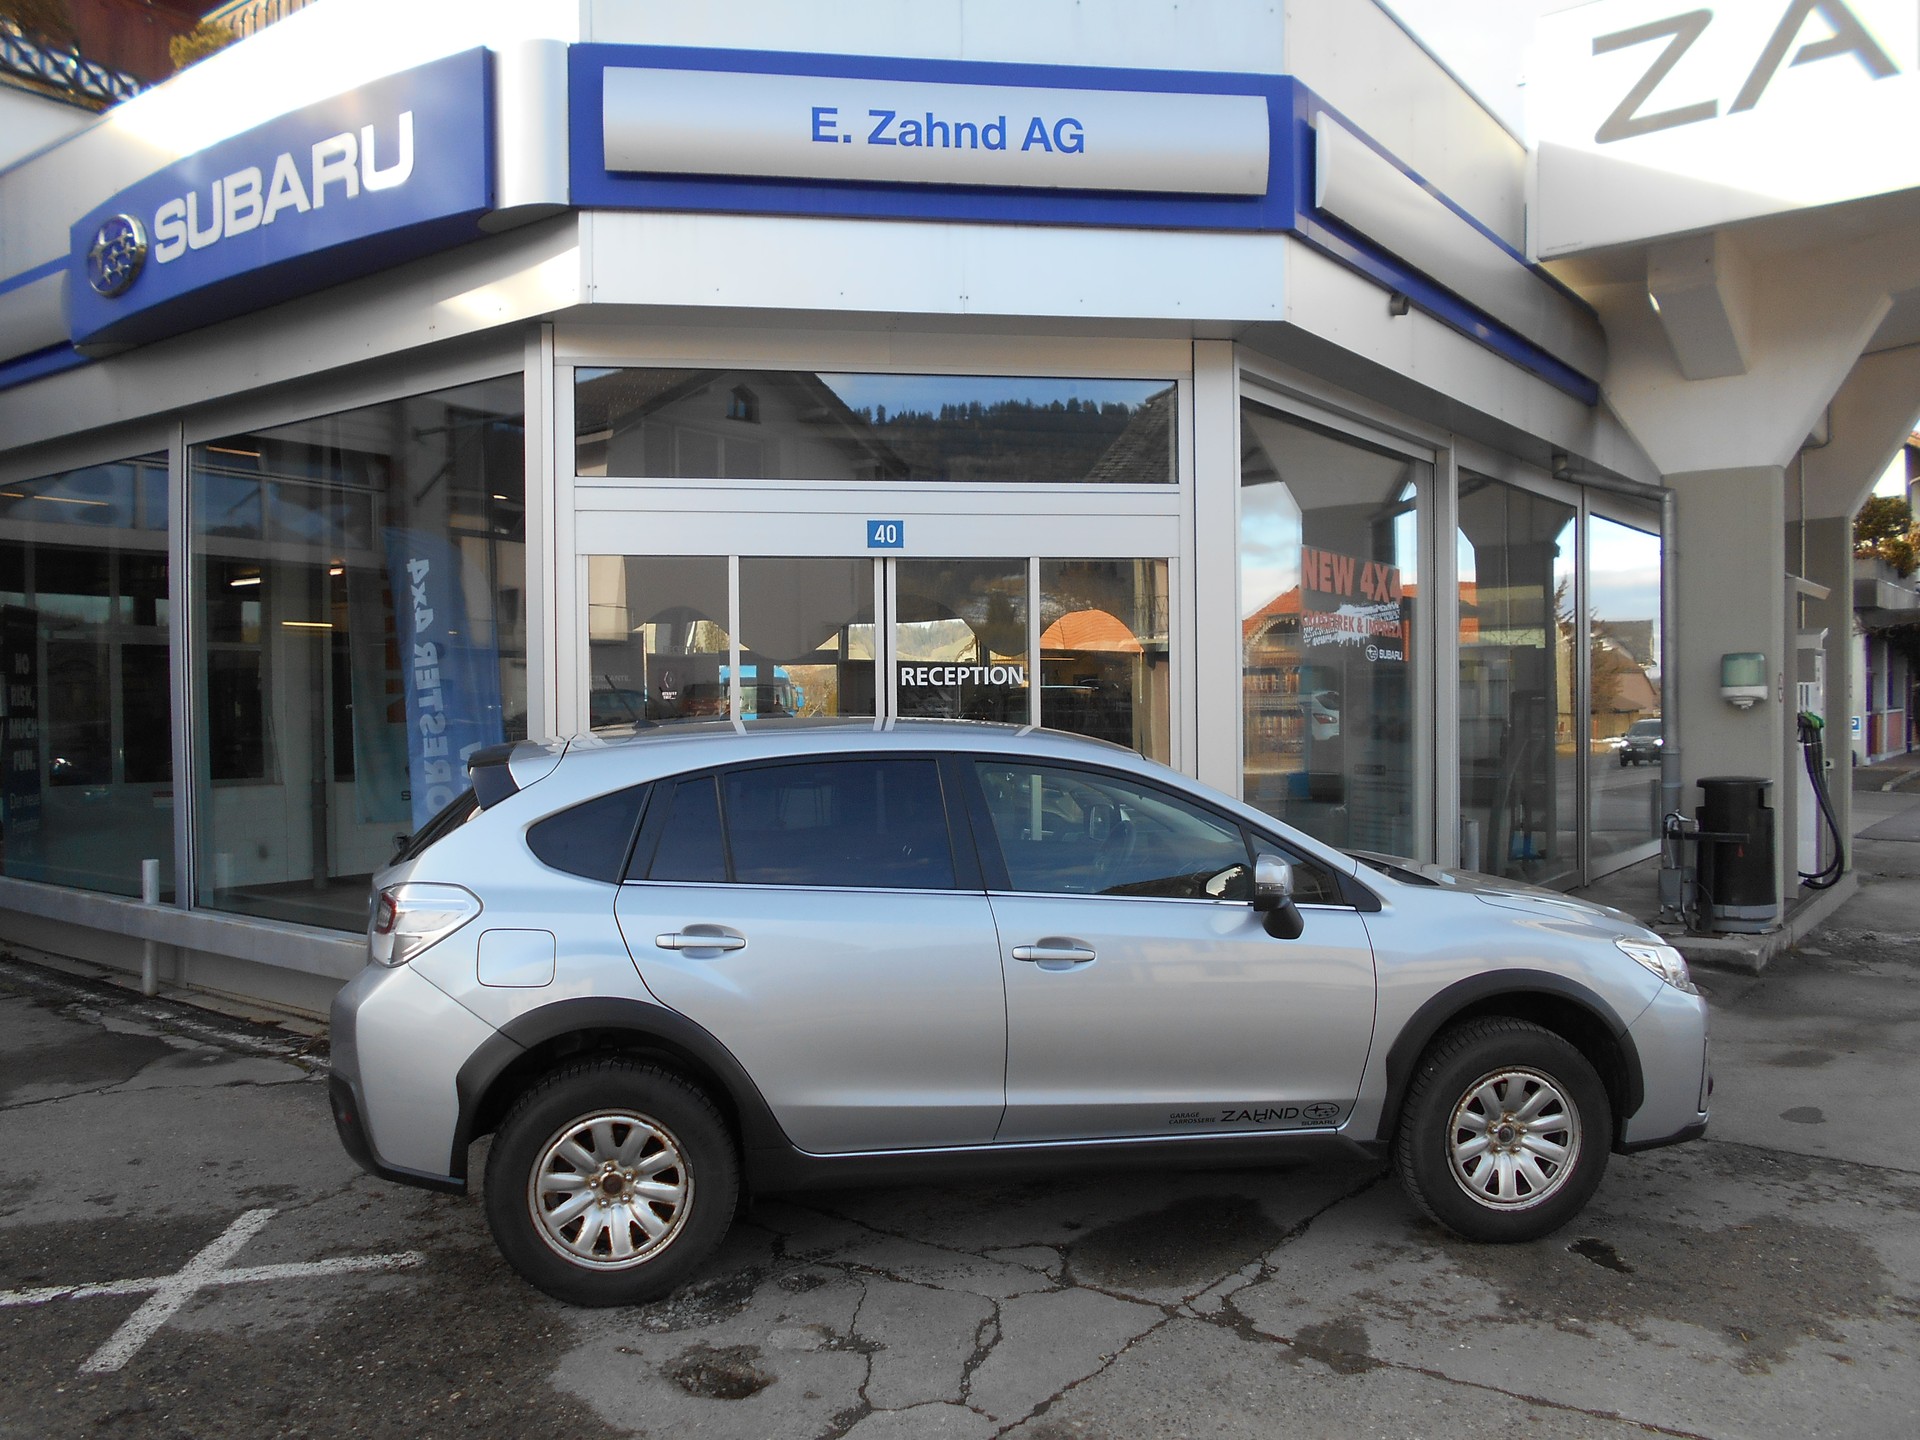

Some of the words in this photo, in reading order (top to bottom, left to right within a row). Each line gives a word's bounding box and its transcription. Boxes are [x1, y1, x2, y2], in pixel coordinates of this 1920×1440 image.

[1592, 0, 1920, 144] ZA
[810, 106, 852, 143] E.
[867, 109, 1007, 150] Zahnd
[1020, 116, 1085, 153] AG
[154, 110, 416, 264] SUBARU
[873, 524, 898, 544] 40
[1301, 548, 1355, 597] NEW
[1356, 617, 1364, 634] &
[1378, 648, 1403, 661] SUBARU
[901, 666, 1025, 687] RECEPTION
[1168, 1116, 1216, 1125] CARROSSERIE
[1169, 1111, 1200, 1119] GARAGE
[1220, 1107, 1300, 1124] ZAHND
[1301, 1118, 1337, 1126] SUBARU
